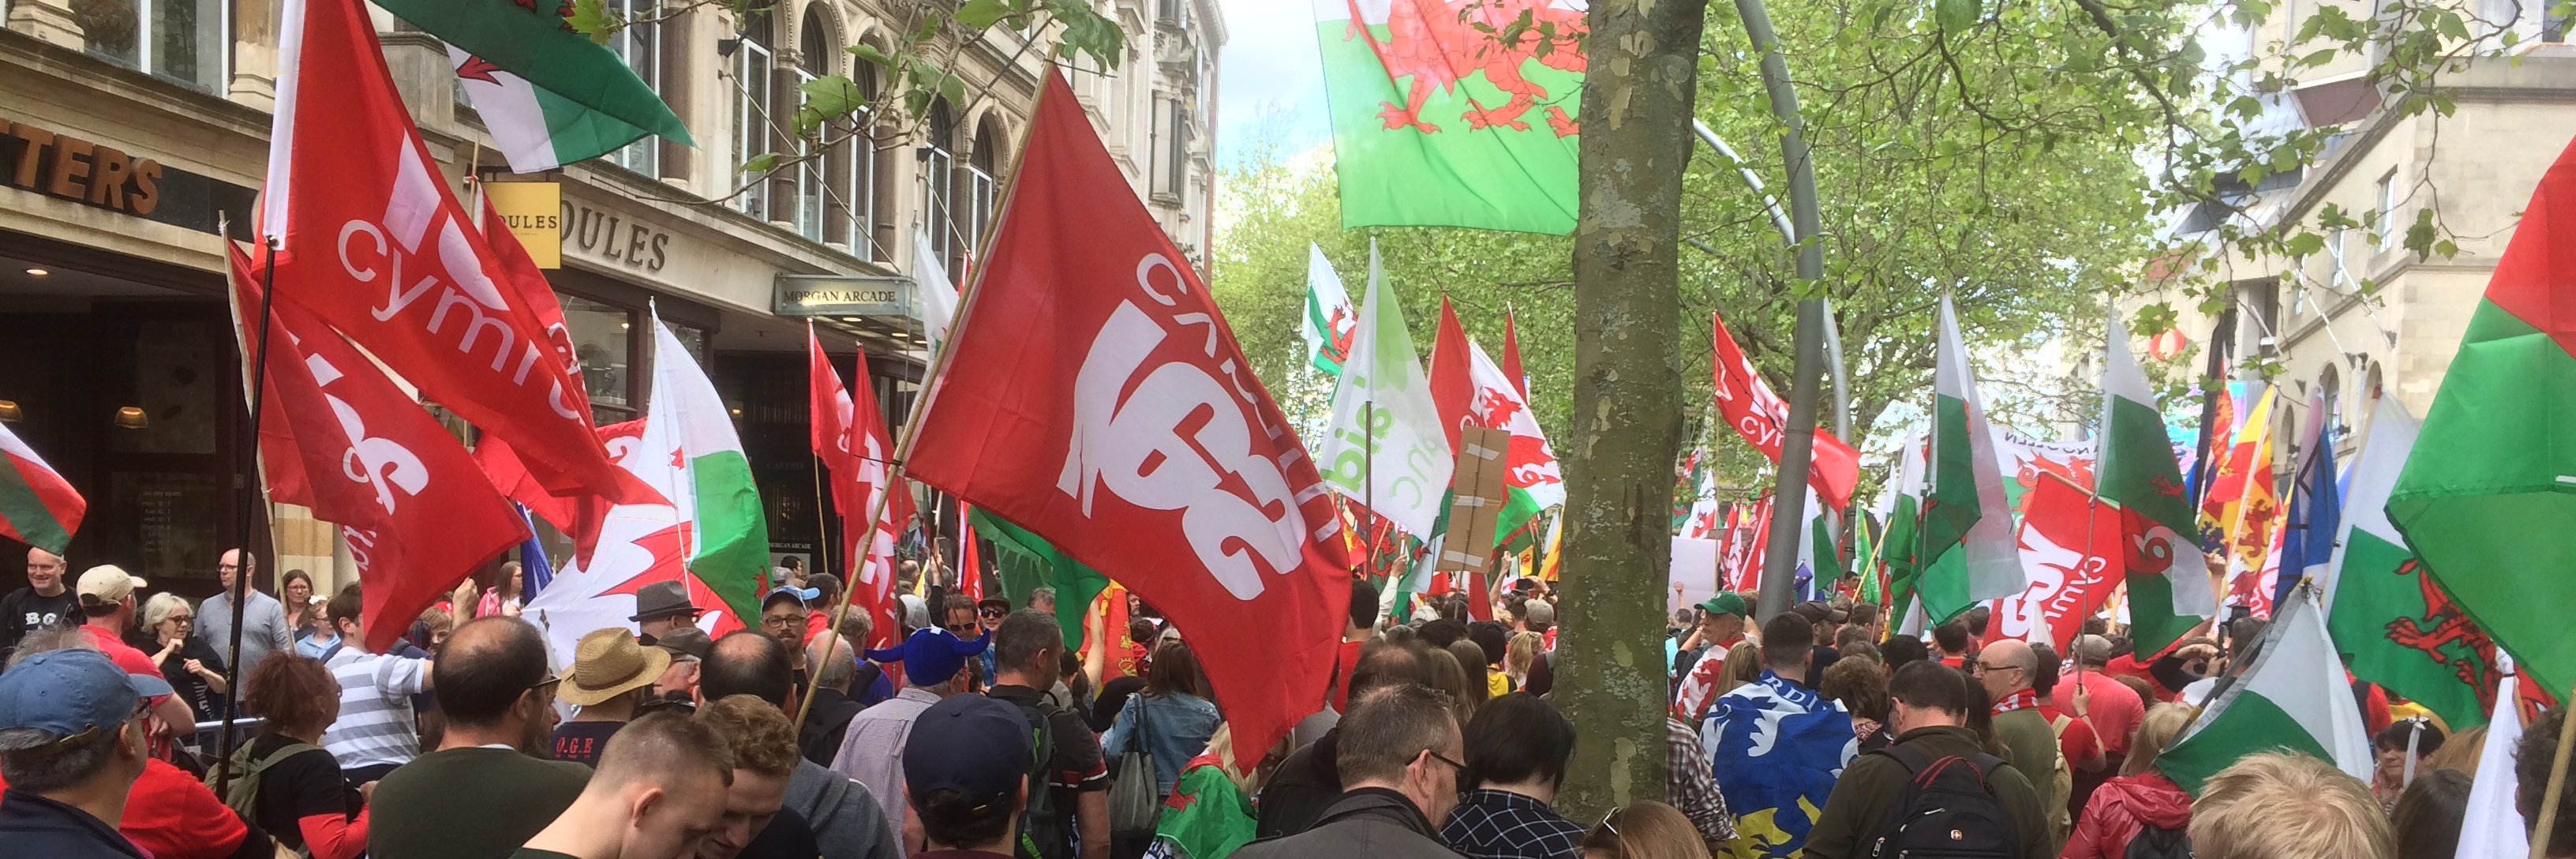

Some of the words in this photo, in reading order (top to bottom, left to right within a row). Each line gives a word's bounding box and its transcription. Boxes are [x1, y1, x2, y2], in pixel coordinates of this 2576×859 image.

[498, 214, 557, 229] ULES
[784, 290, 838, 302] MORGAN
[843, 290, 897, 302] ARCADE
